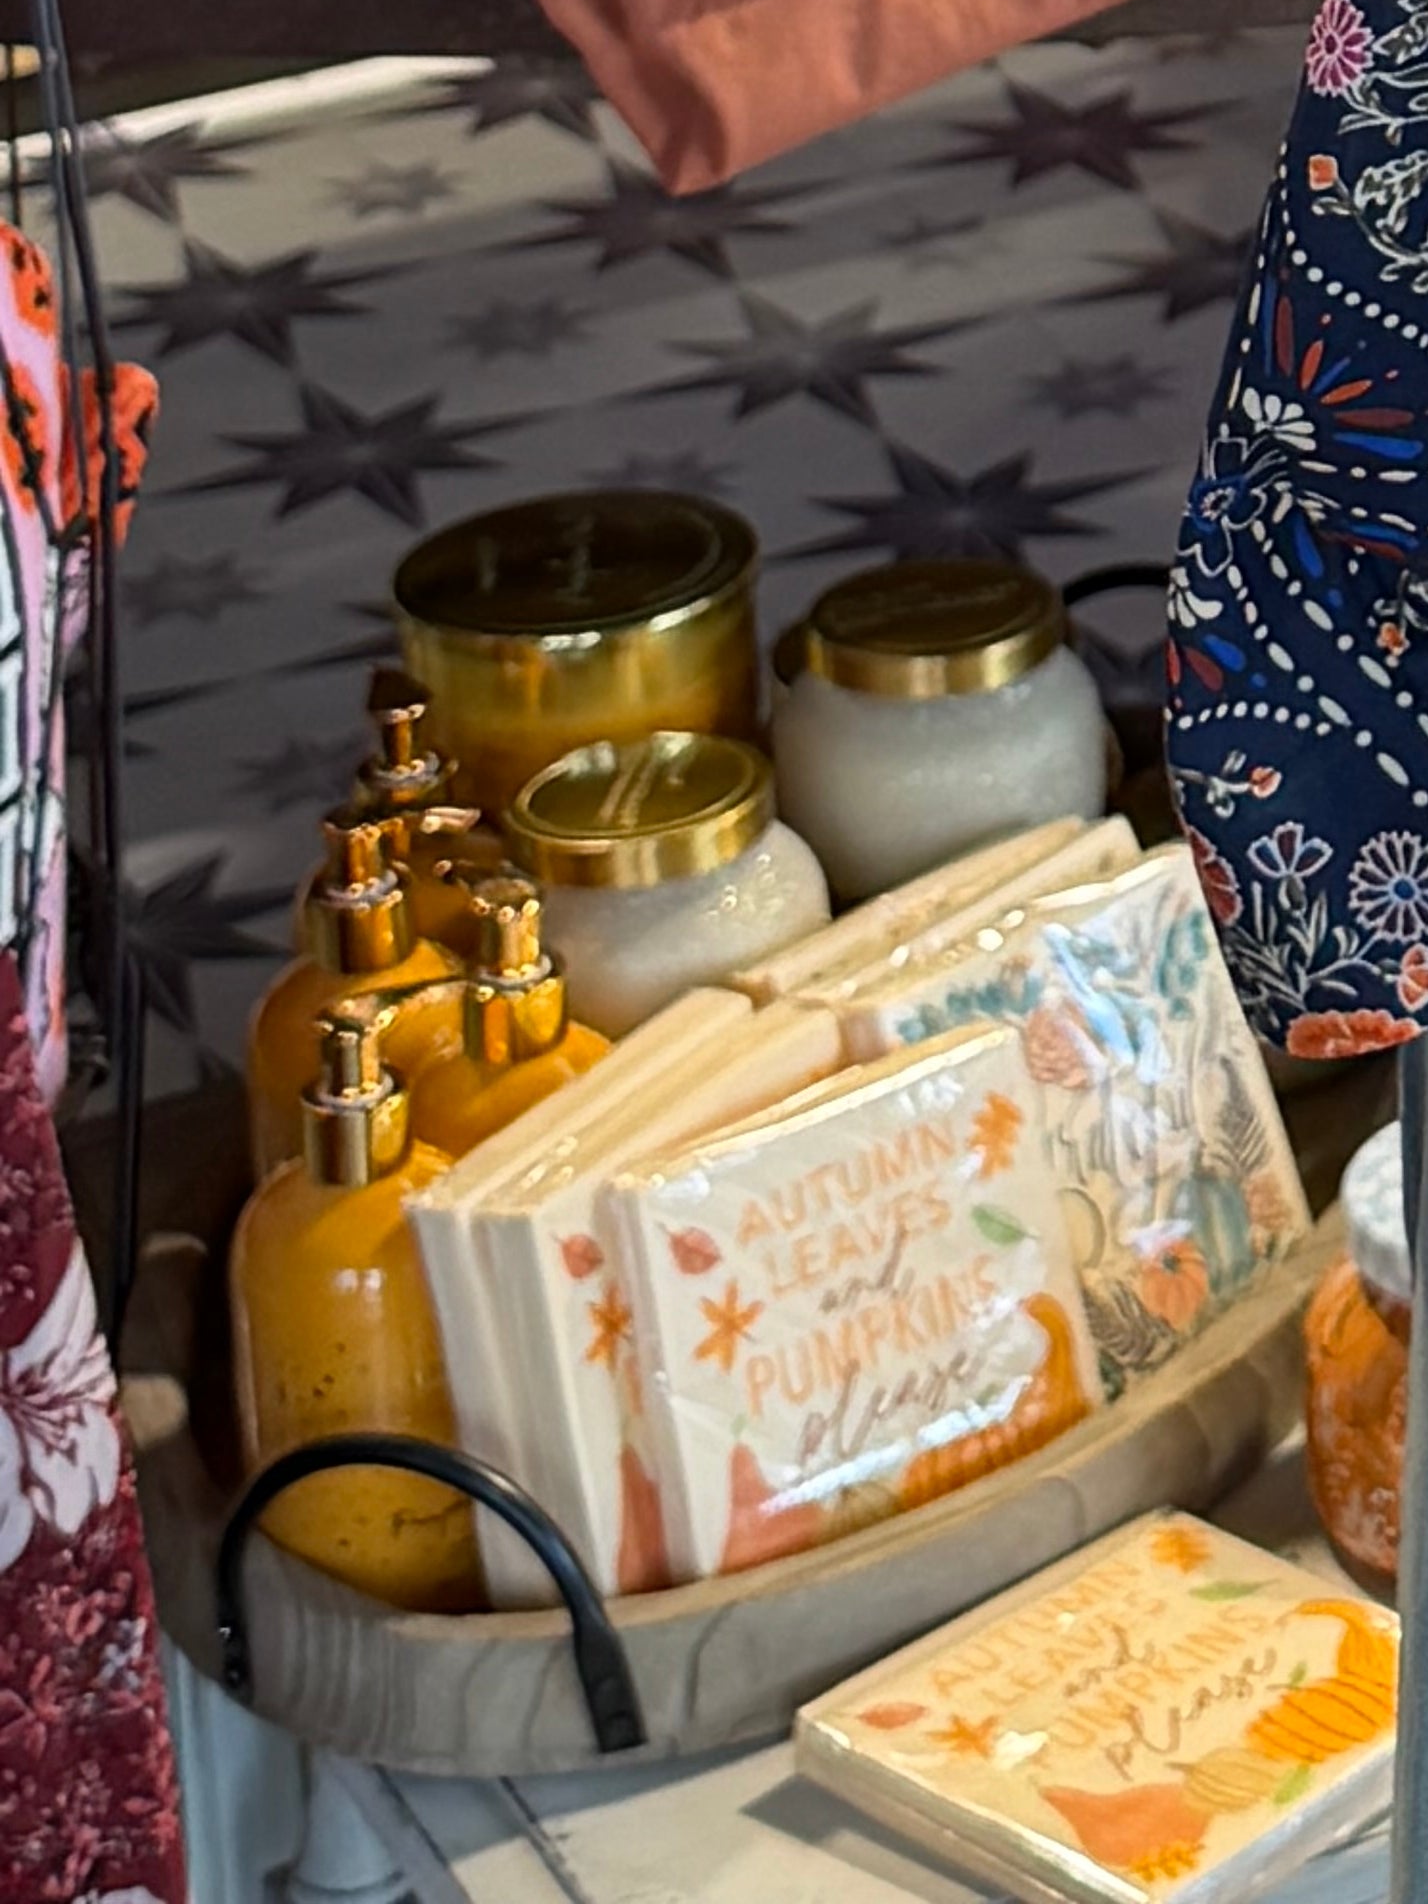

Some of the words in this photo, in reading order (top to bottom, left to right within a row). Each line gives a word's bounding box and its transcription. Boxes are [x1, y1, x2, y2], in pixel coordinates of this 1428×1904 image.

[736, 1118, 957, 1249] AUTUMN
[761, 1182, 953, 1300] LEAVES
[931, 1557, 1140, 1698] AUTUMN
